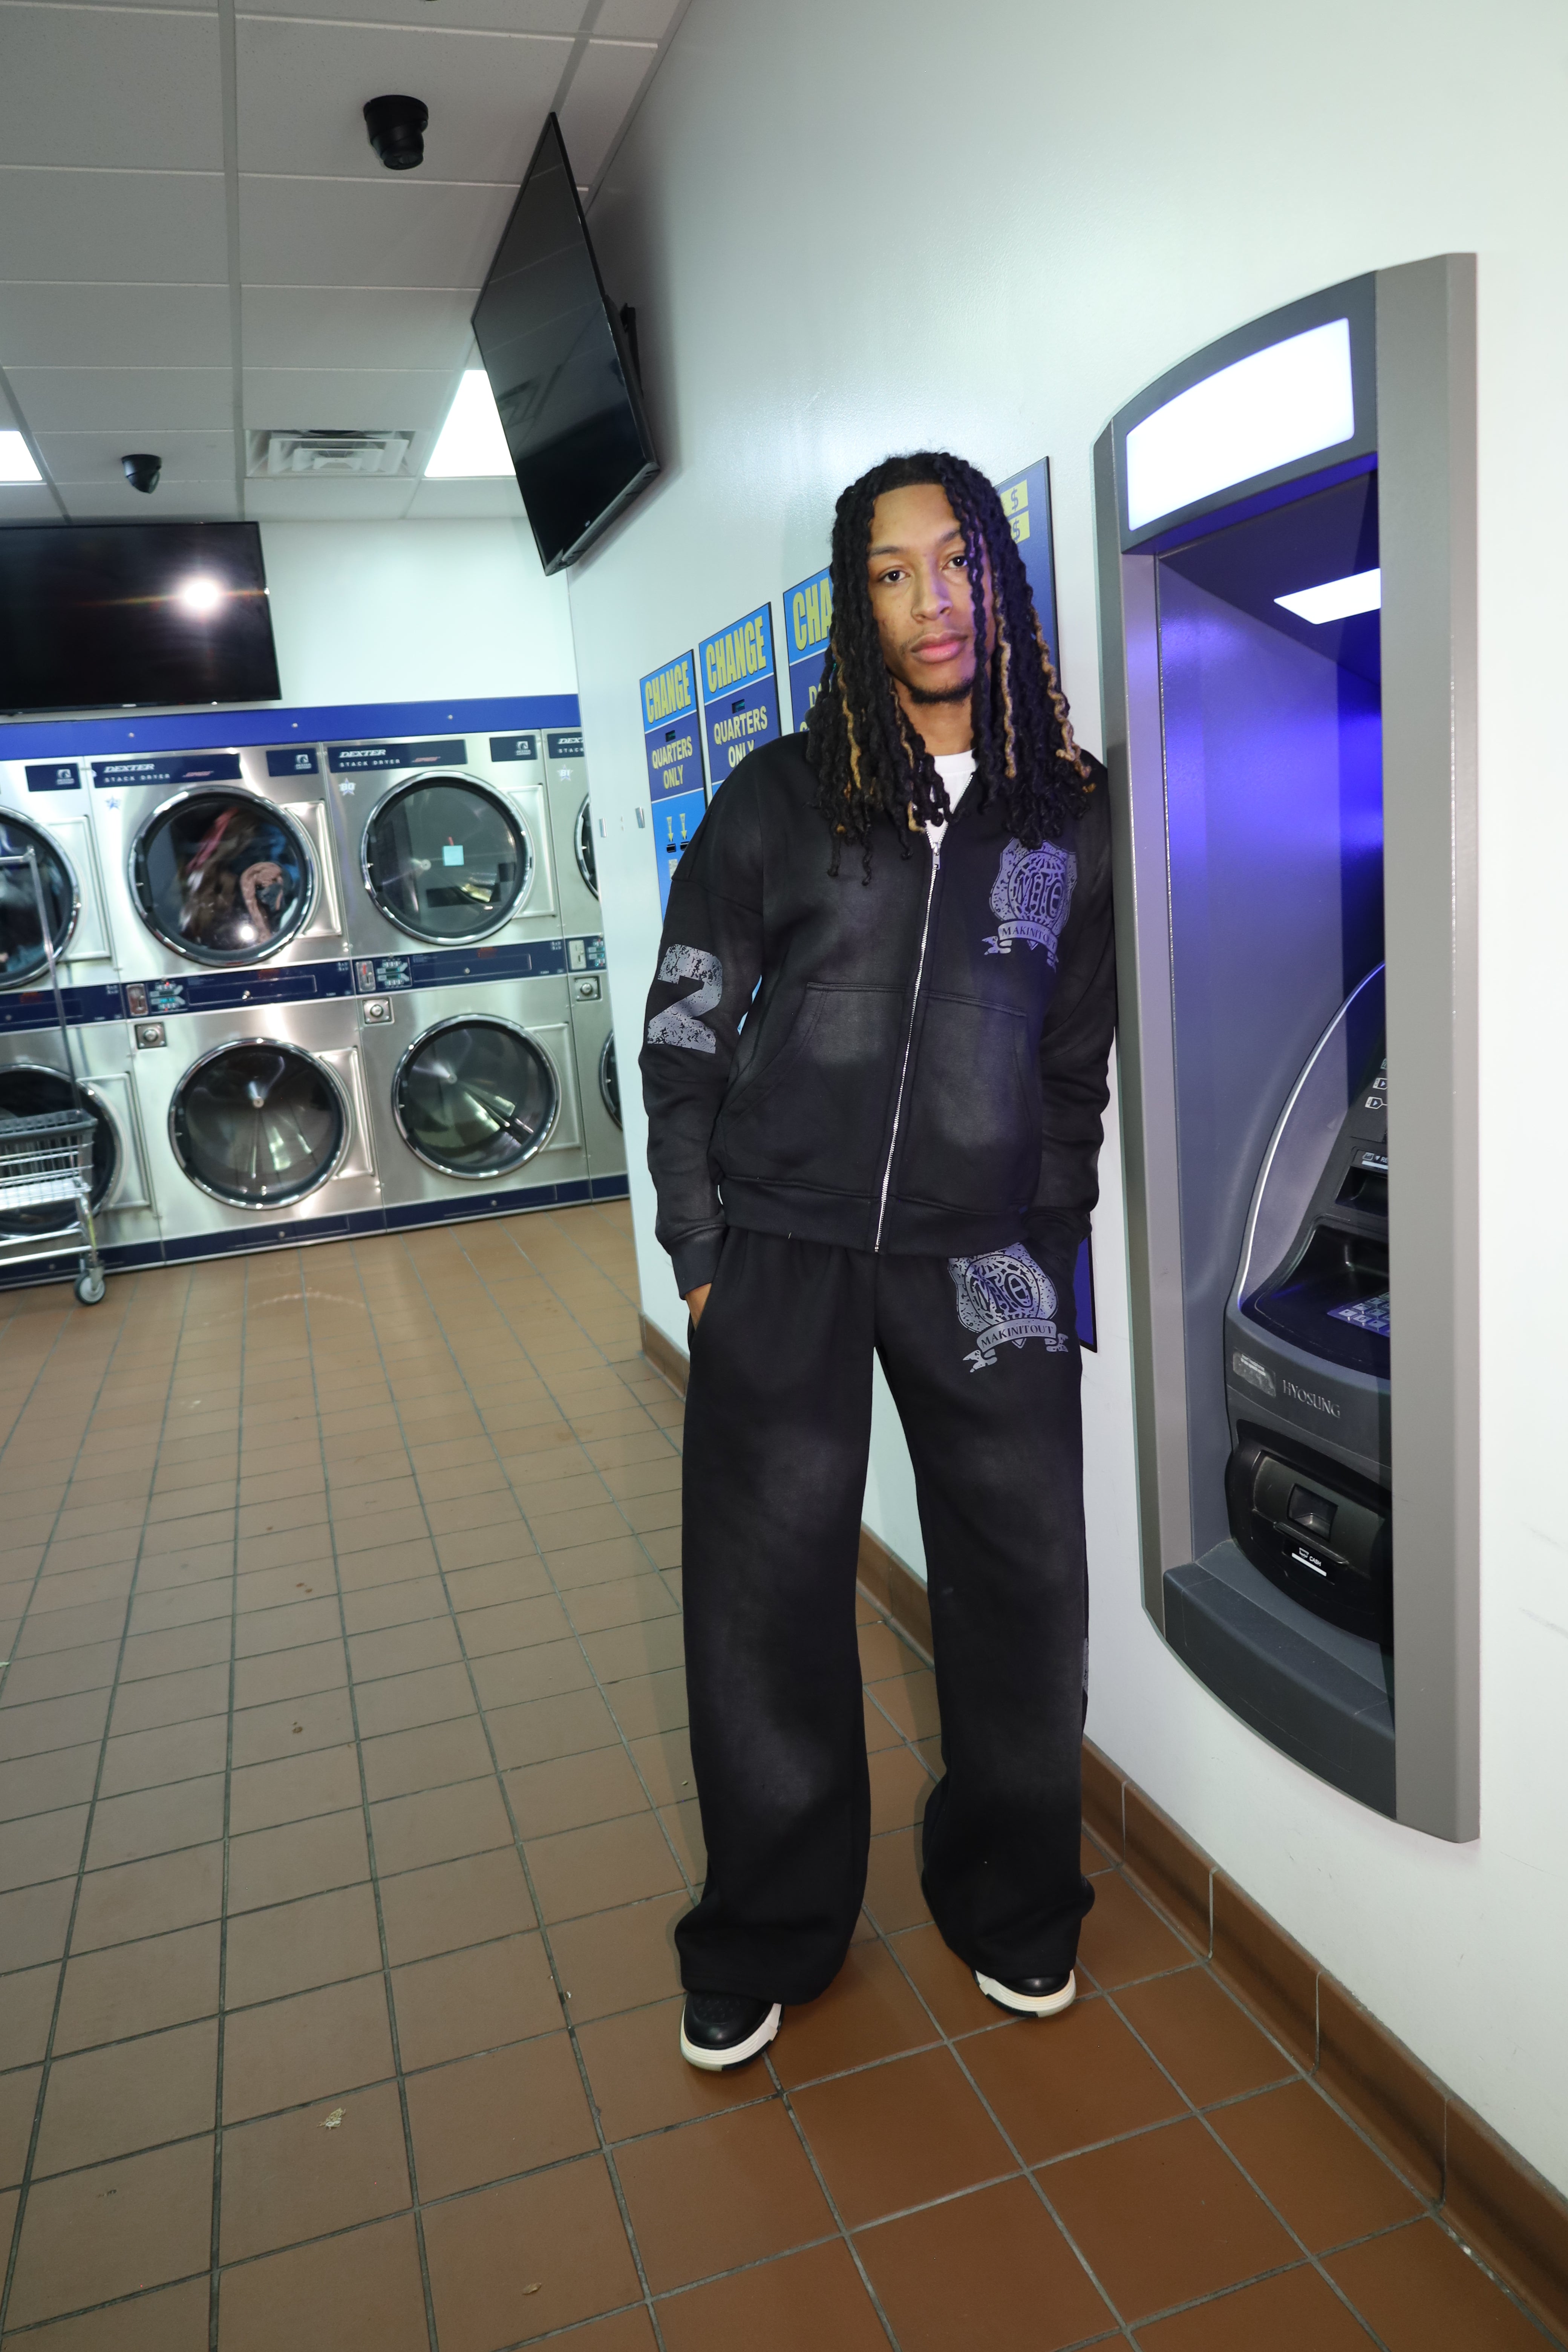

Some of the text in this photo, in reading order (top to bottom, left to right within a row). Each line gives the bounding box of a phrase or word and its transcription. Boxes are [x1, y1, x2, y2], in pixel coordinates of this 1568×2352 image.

[793, 577, 833, 651] CHA
[706, 615, 766, 693] CHANGE
[645, 660, 691, 724] CHANGE
[714, 706, 767, 745] QUARTERS
[339, 749, 386, 758] DEXTER
[652, 736, 693, 769] QUARTERS
[104, 763, 155, 773] DEXTER
[663, 764, 683, 789] ONLY
[340, 782, 355, 792] 80
[1002, 926, 1056, 949] MAKINITOUT
[981, 1324, 1054, 1348] MAKINITOUT
[1283, 1380, 1340, 1418] HYOSUNG
[1309, 1556, 1321, 1566] CASH
